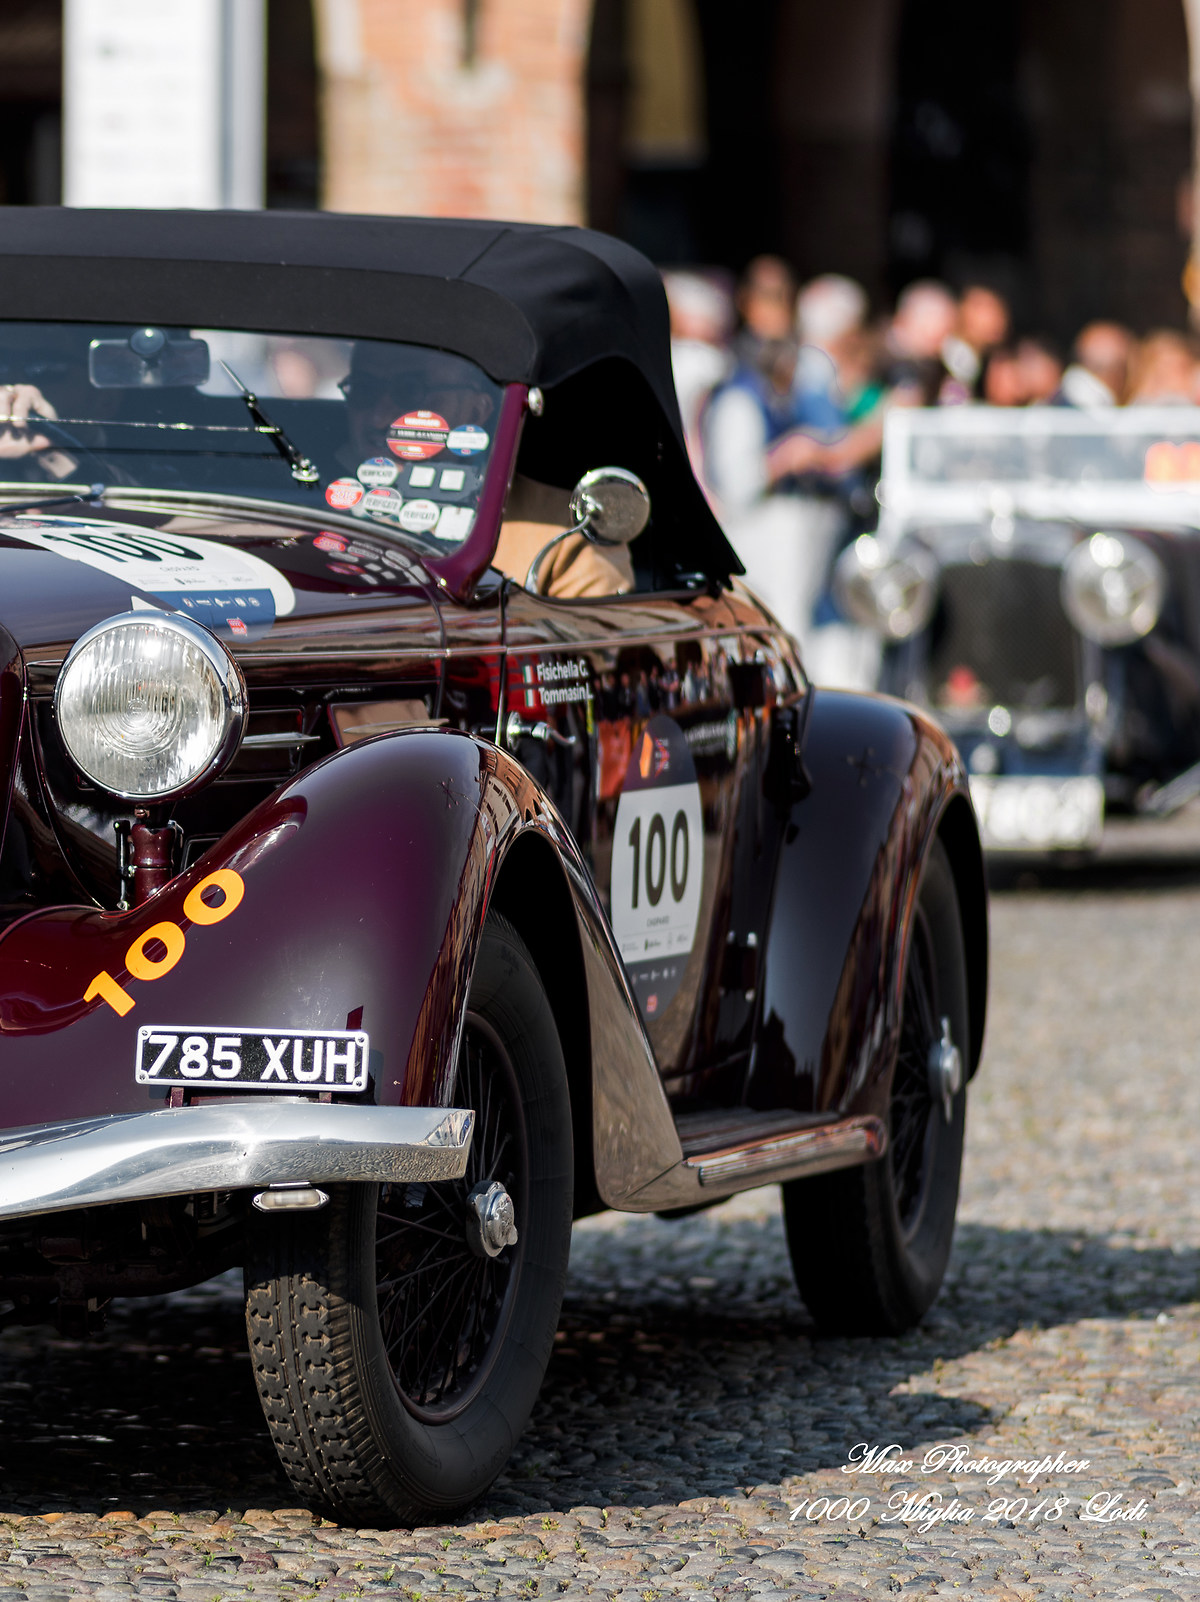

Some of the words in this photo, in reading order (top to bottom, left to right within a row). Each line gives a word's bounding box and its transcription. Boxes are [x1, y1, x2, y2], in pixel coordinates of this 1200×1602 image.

[40, 532, 204, 563] 100
[536, 660, 579, 681] Fisichella
[628, 809, 689, 909] 100
[83, 868, 245, 1017] 100
[148, 1034, 242, 1078] 785
[260, 1038, 356, 1083] XUH
